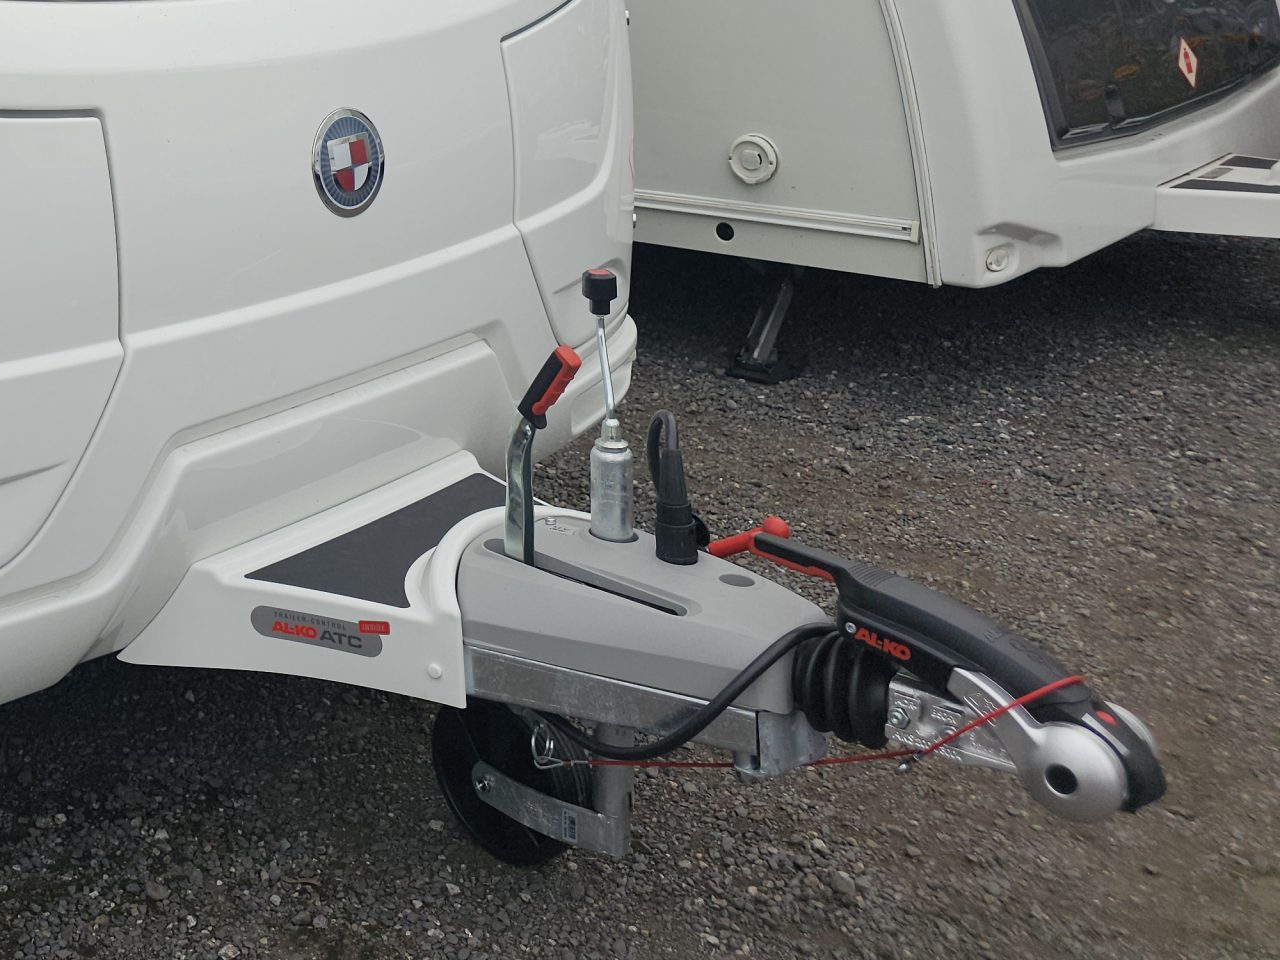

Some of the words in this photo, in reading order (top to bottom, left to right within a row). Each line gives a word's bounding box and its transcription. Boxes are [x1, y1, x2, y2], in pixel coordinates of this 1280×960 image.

[272, 620, 318, 639] AL-KO
[320, 630, 363, 649] ATC
[854, 627, 911, 660] AL-KO
